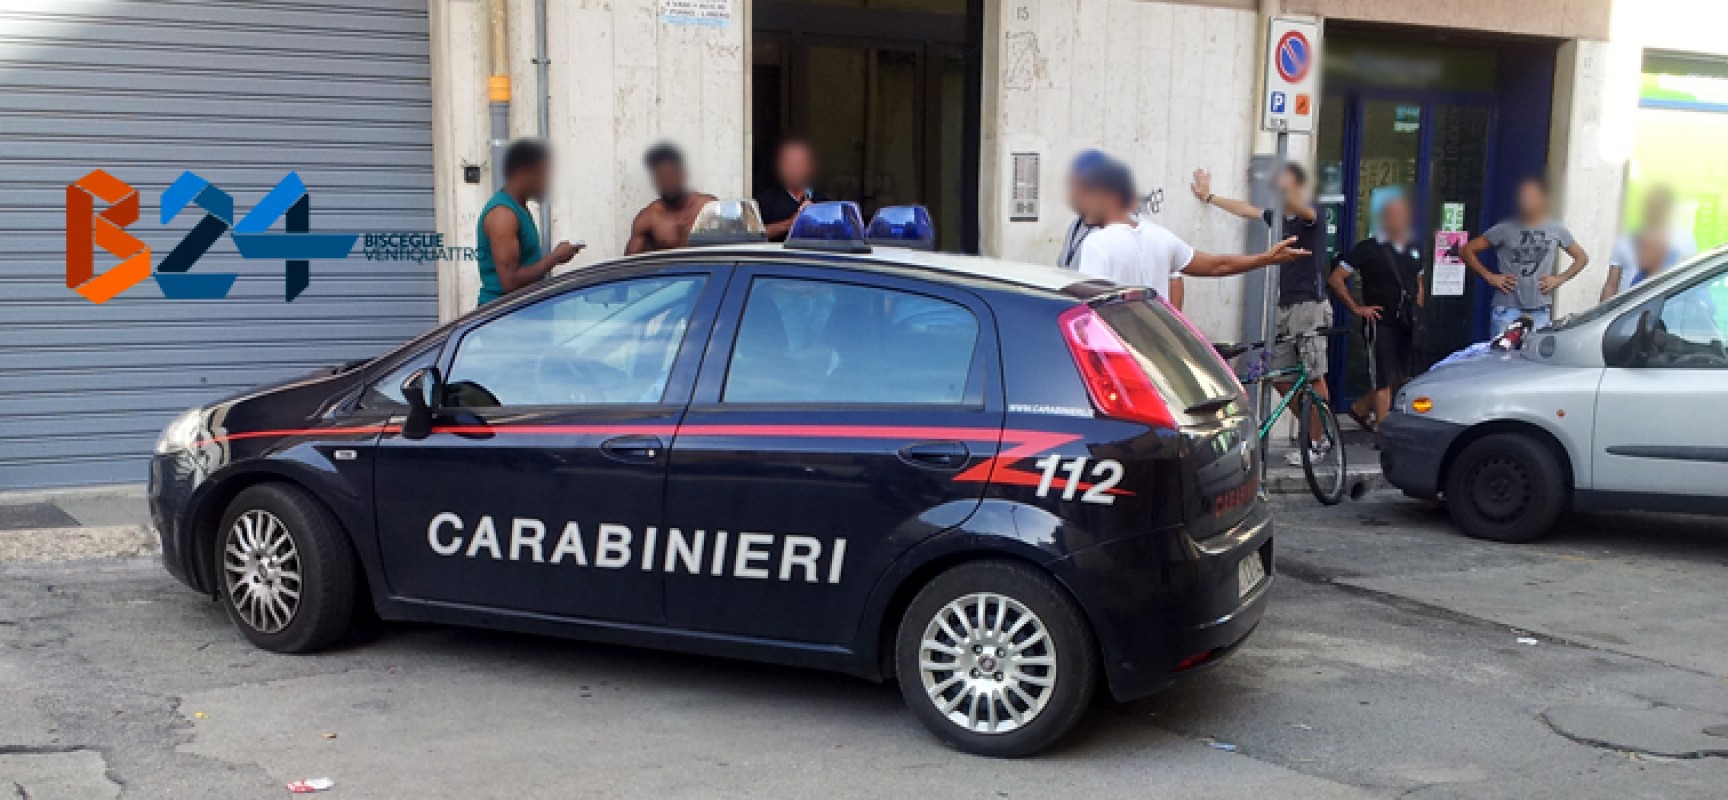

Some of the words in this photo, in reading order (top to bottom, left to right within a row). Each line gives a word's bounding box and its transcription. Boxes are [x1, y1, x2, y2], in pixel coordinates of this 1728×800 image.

[1016, 6, 1030, 21] 15
[1273, 95, 1283, 111] P
[1035, 453, 1125, 504] 112
[427, 511, 847, 584] CARABINIERI
